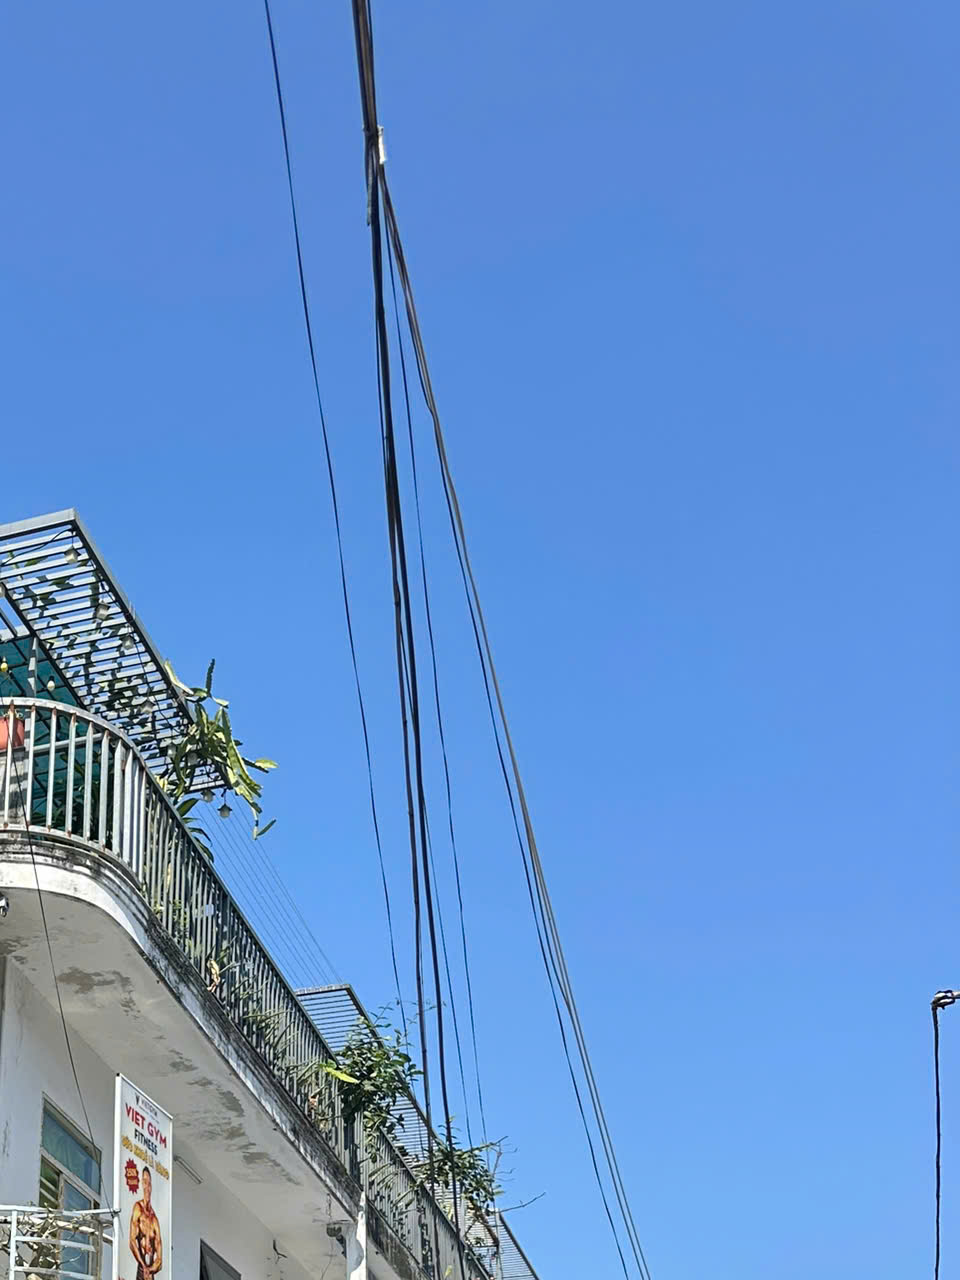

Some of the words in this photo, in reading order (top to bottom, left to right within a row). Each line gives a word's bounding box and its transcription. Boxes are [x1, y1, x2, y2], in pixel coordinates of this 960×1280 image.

[125, 1102, 146, 1130] VIET
[147, 1122, 168, 1149] GYM
[134, 1128, 158, 1156] FITNESS
